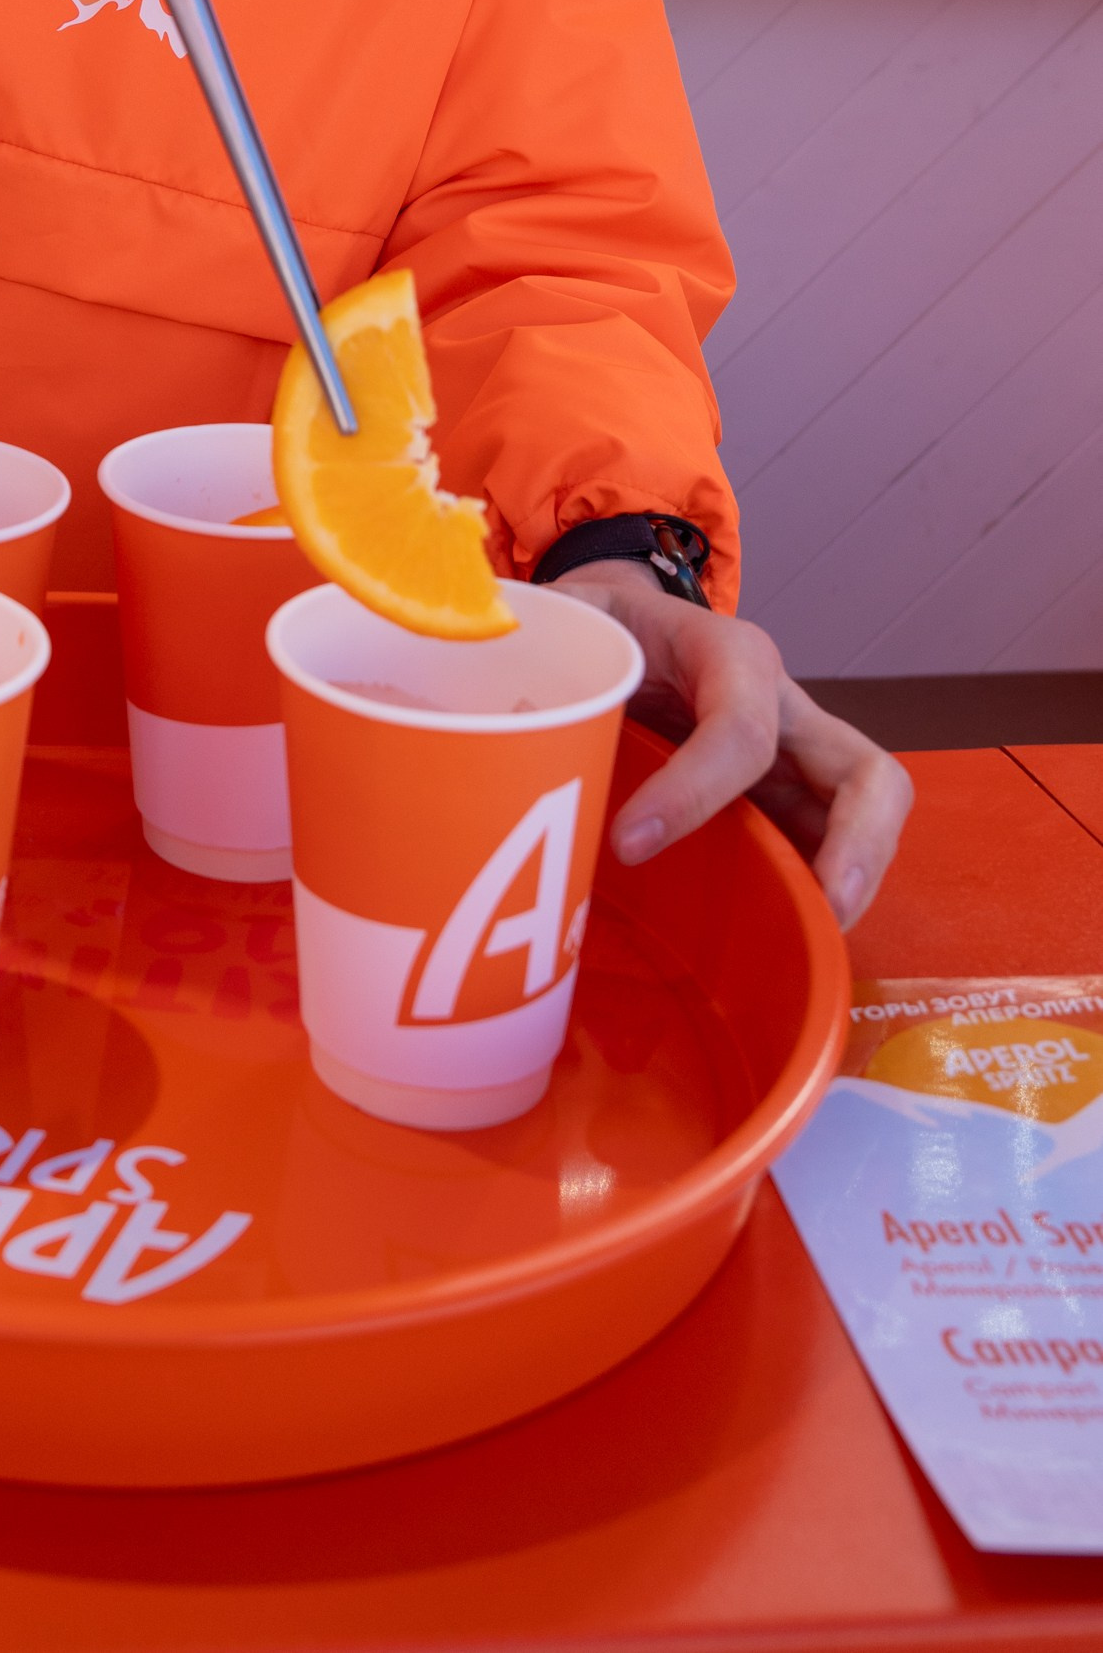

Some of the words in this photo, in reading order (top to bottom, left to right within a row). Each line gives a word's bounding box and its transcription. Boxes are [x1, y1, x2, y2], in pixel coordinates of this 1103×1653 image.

[411, 776, 582, 1019] A
[850, 999, 928, 1023] ГОРЫ
[931, 989, 1018, 1013] ЗОВУТ
[946, 1038, 1090, 1079] APEROL
[881, 1208, 1023, 1255] Aperol
